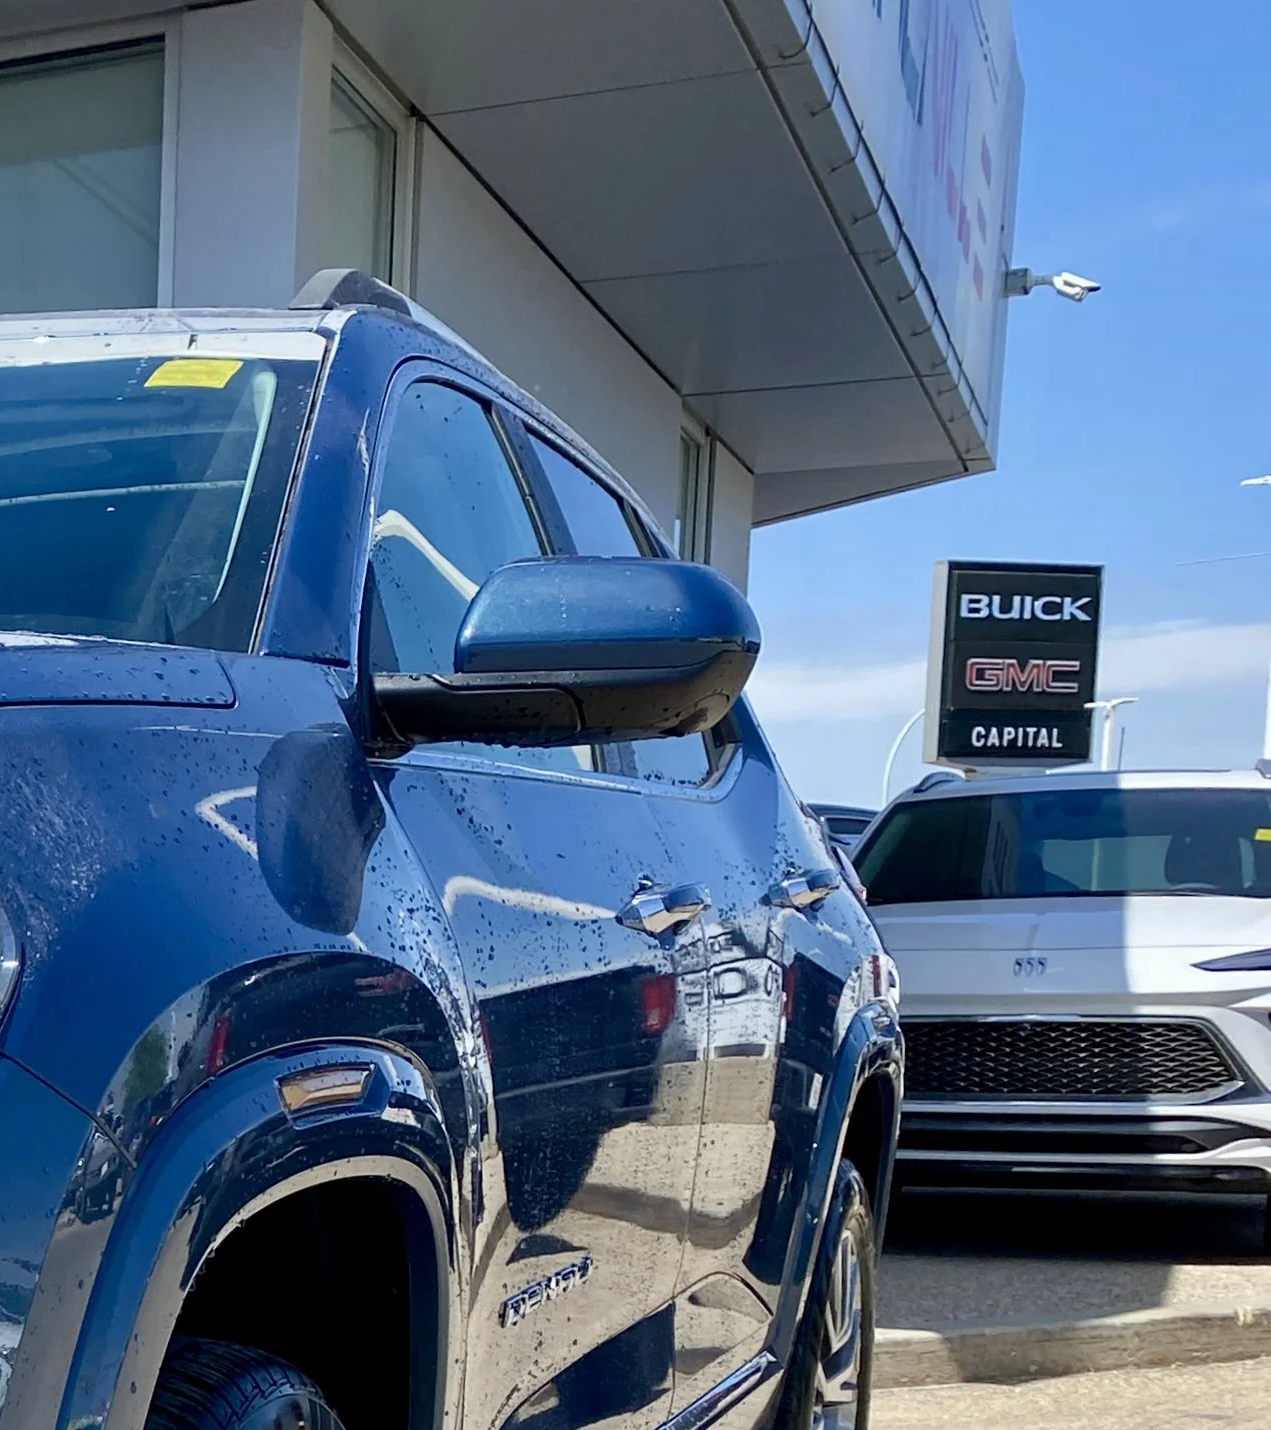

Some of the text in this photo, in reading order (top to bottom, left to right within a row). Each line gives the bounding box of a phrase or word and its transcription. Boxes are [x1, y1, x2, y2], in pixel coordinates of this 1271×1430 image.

[960, 594, 1092, 621] BUICK
[966, 657, 1081, 693] GMC
[971, 726, 1063, 748] CAPITAL
